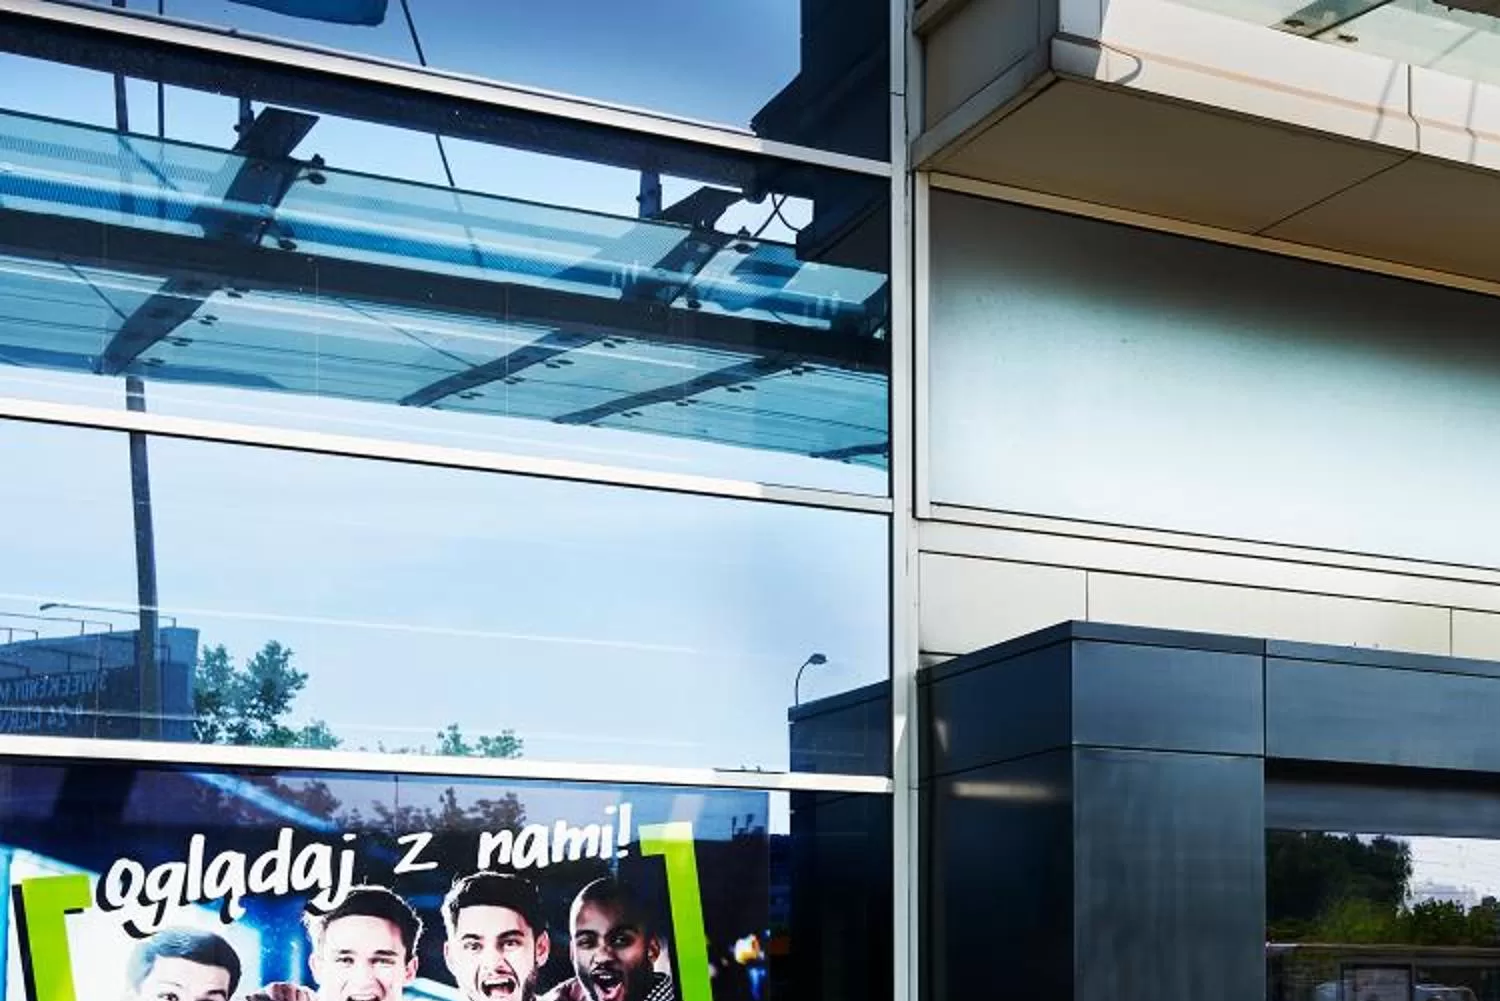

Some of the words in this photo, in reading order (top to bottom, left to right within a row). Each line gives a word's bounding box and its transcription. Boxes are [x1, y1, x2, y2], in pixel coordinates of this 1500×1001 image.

[102, 827, 357, 930] oglądaj
[393, 833, 439, 874] z
[476, 802, 633, 871] nami!
